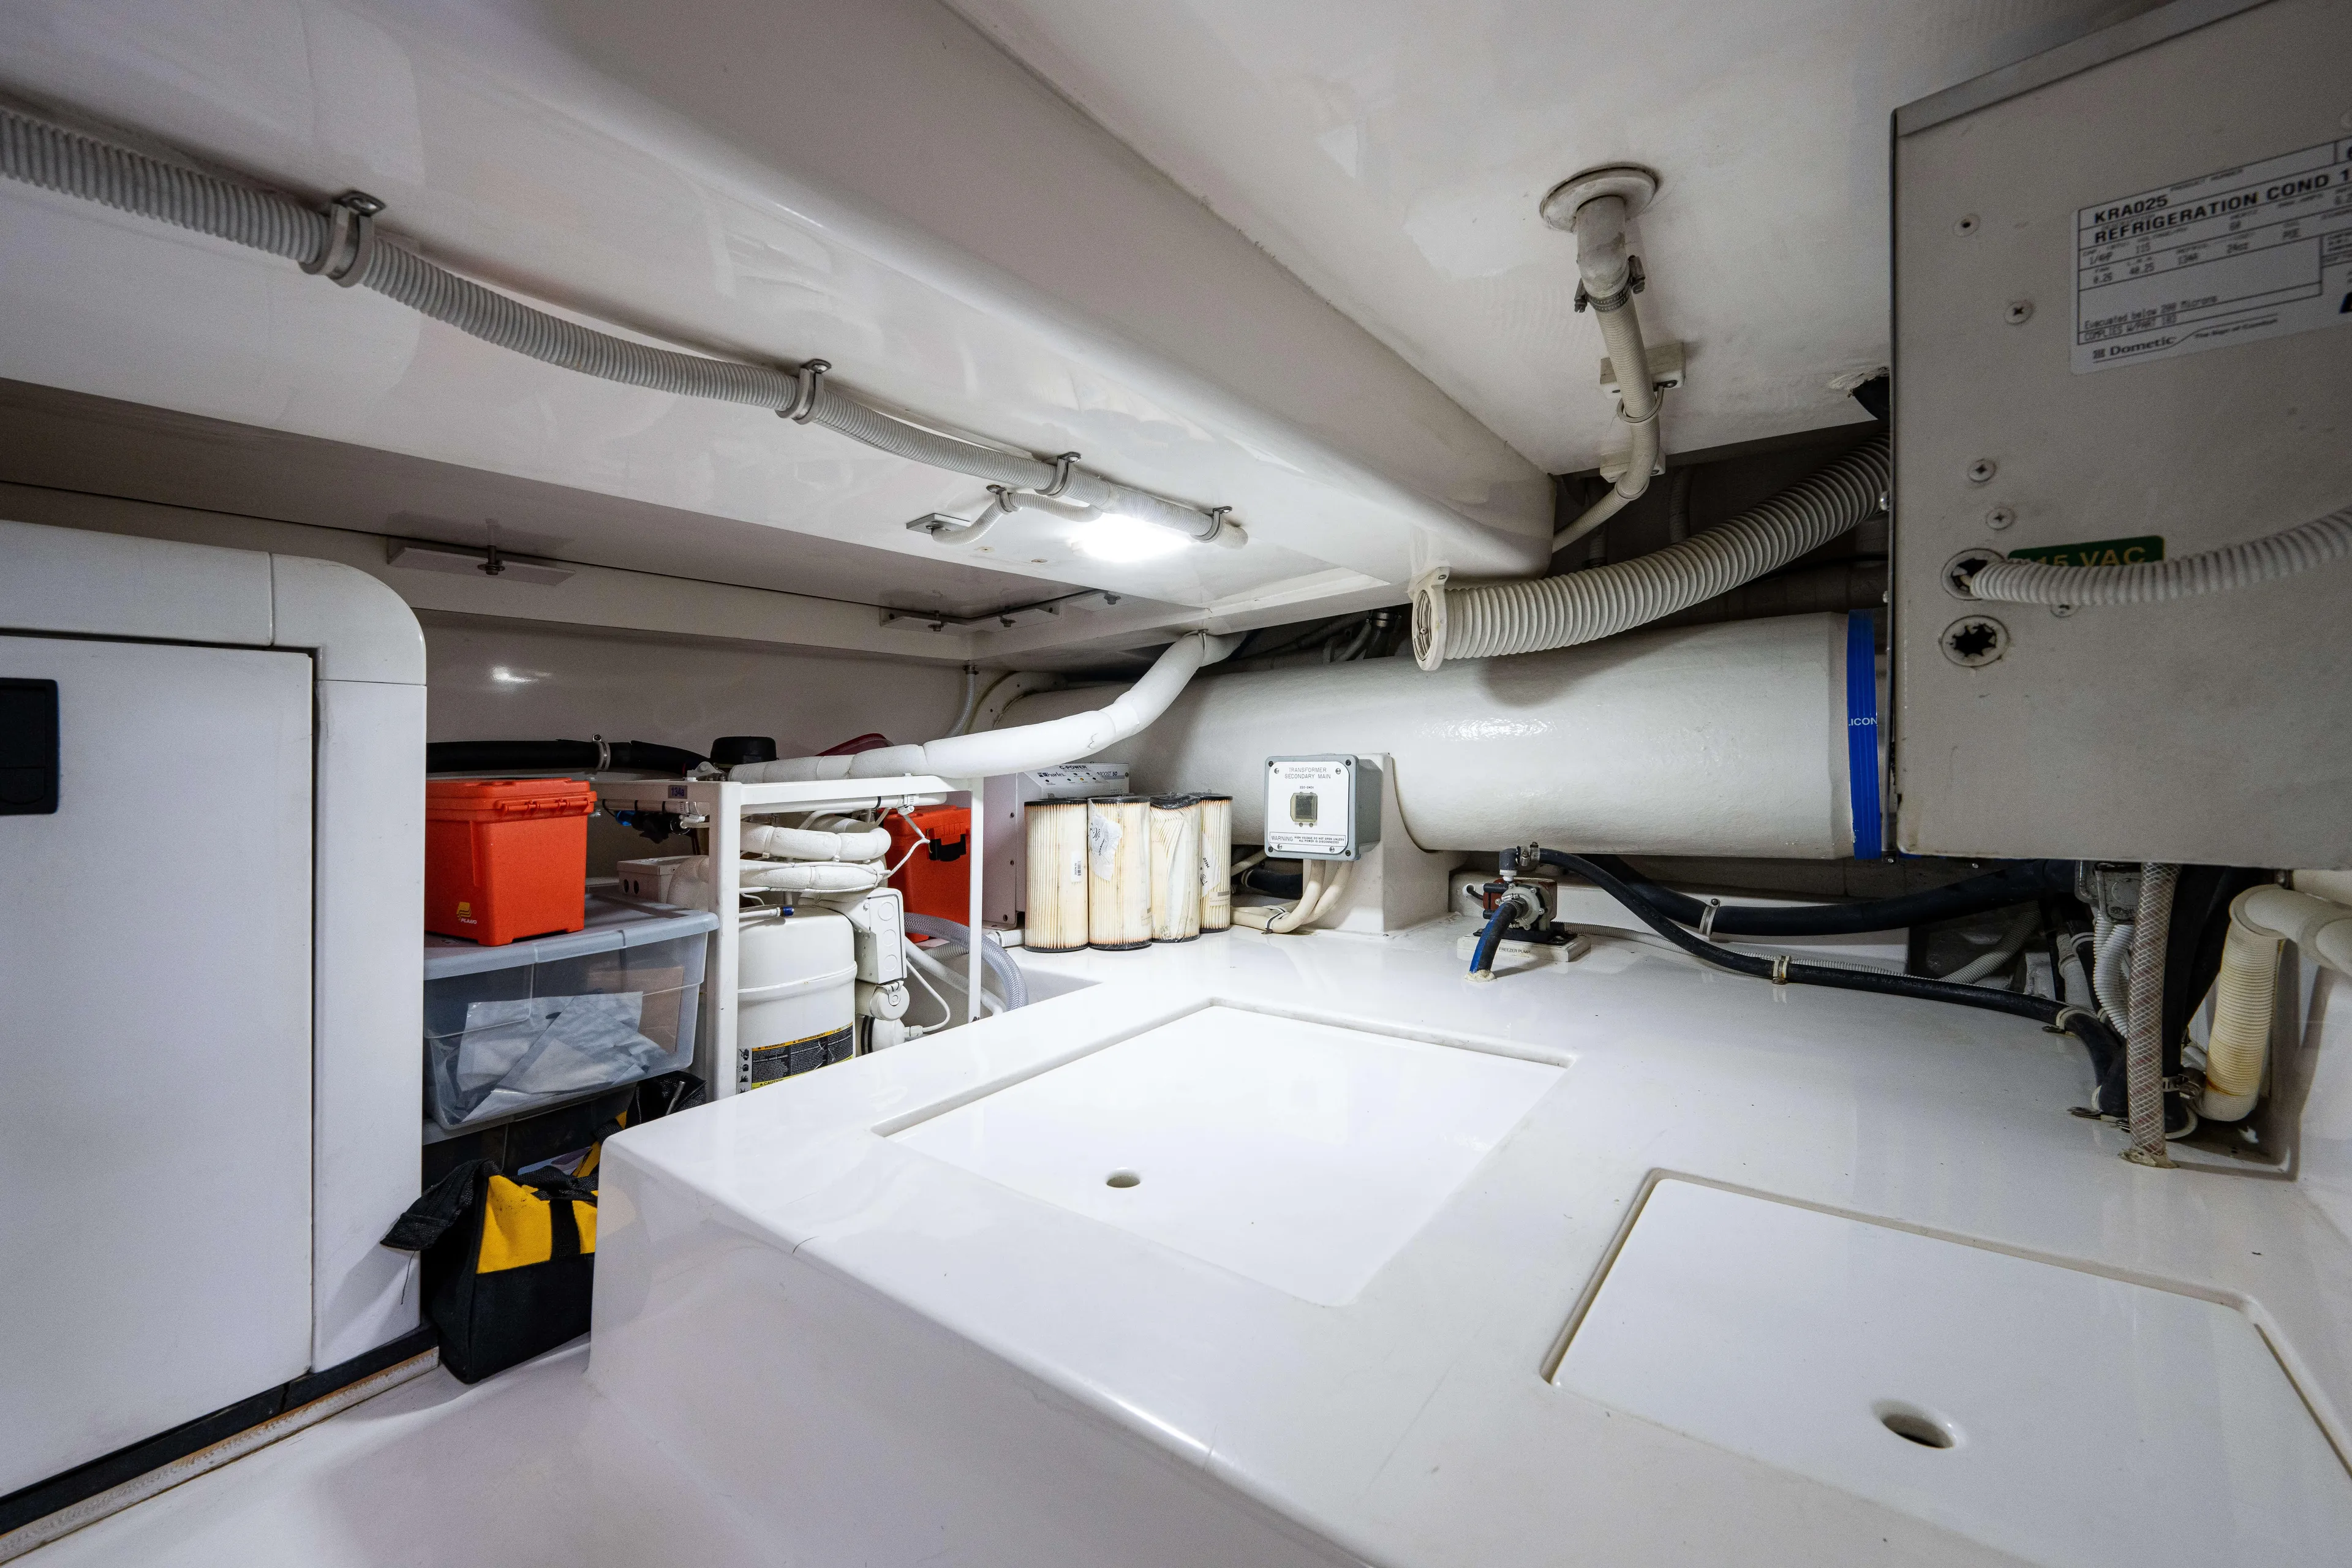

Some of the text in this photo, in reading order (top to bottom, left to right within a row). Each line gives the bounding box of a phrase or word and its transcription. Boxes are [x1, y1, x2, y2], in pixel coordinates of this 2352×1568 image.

[2095, 194, 2168, 224] KRA025
[2095, 190, 2259, 244] REFRIGERATION
[2265, 174, 2329, 201] COND
[2110, 336, 2177, 356] Dometic
[2079, 546, 2145, 567] VAC
[1849, 717, 1877, 726] ICON
[671, 786, 685, 797] 134a
[797, 1032, 826, 1042] AVERTISSEMENT
